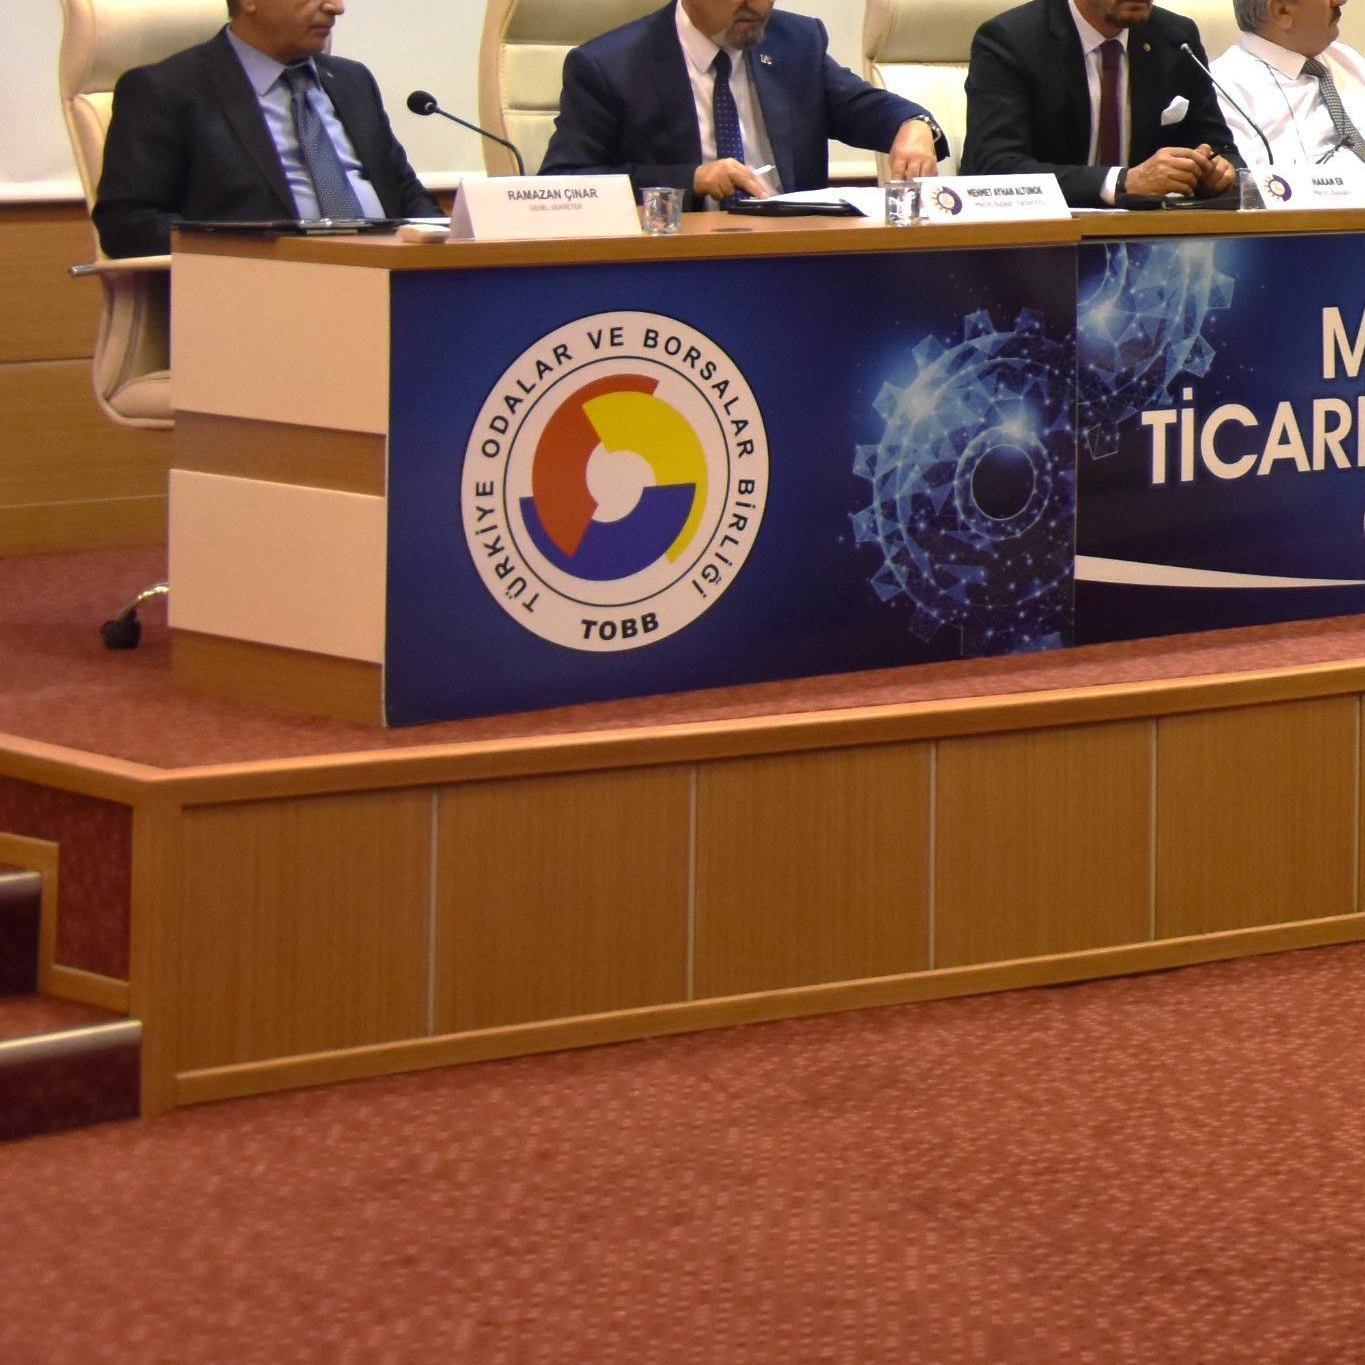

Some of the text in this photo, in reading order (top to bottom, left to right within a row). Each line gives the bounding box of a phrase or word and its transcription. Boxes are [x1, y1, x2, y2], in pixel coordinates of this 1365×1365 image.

[507, 188, 598, 202] RAMAZAN ÇINAR
[476, 326, 756, 613] TÜRKİYE ODALAR VE BORSALAR BİRLİĞİ
[580, 612, 660, 641] TOBB
